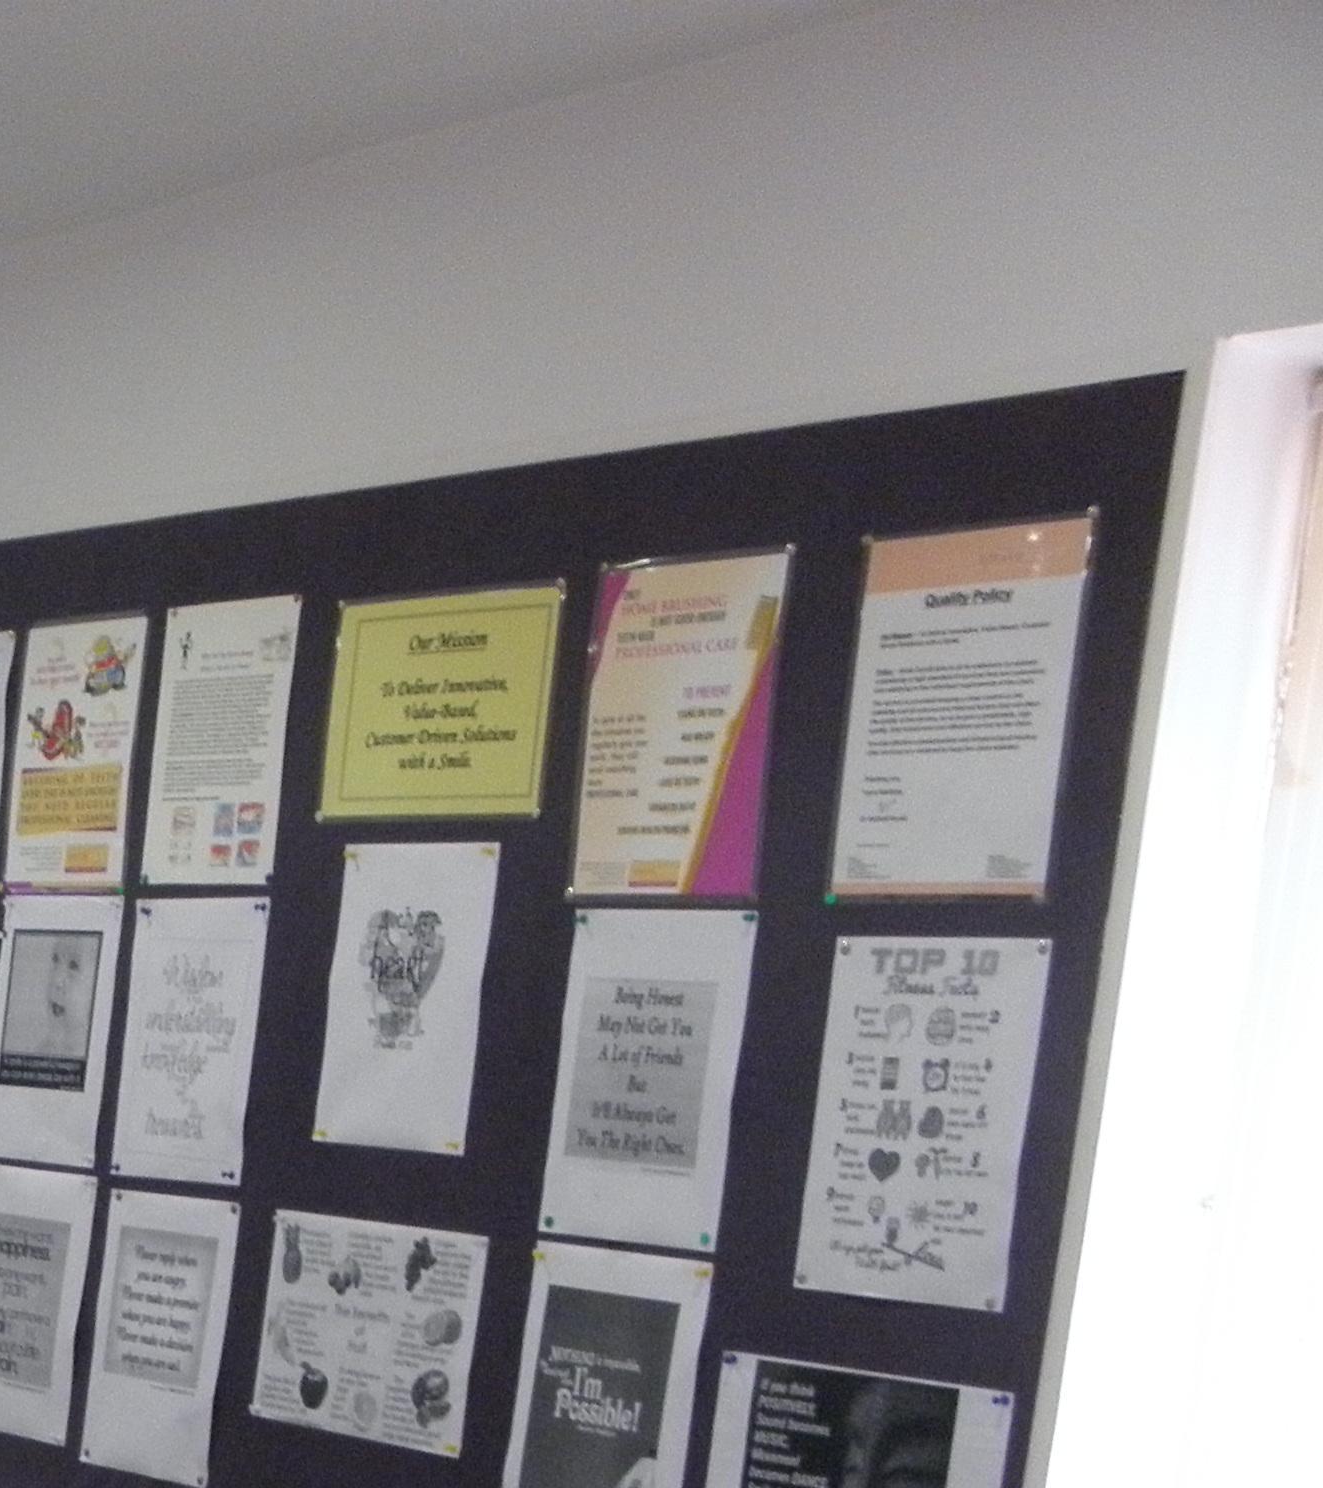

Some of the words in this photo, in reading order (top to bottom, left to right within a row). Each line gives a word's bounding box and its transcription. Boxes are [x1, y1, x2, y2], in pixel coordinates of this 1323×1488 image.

[924, 593, 969, 609] Quality
[973, 588, 1013, 605] Policy
[409, 635, 434, 651] Our
[436, 632, 488, 650] Mission
[871, 948, 946, 976] TOP
[960, 948, 1001, 977] 10
[573, 1366, 603, 1400] I'm
[553, 1387, 643, 1434] Possible!
